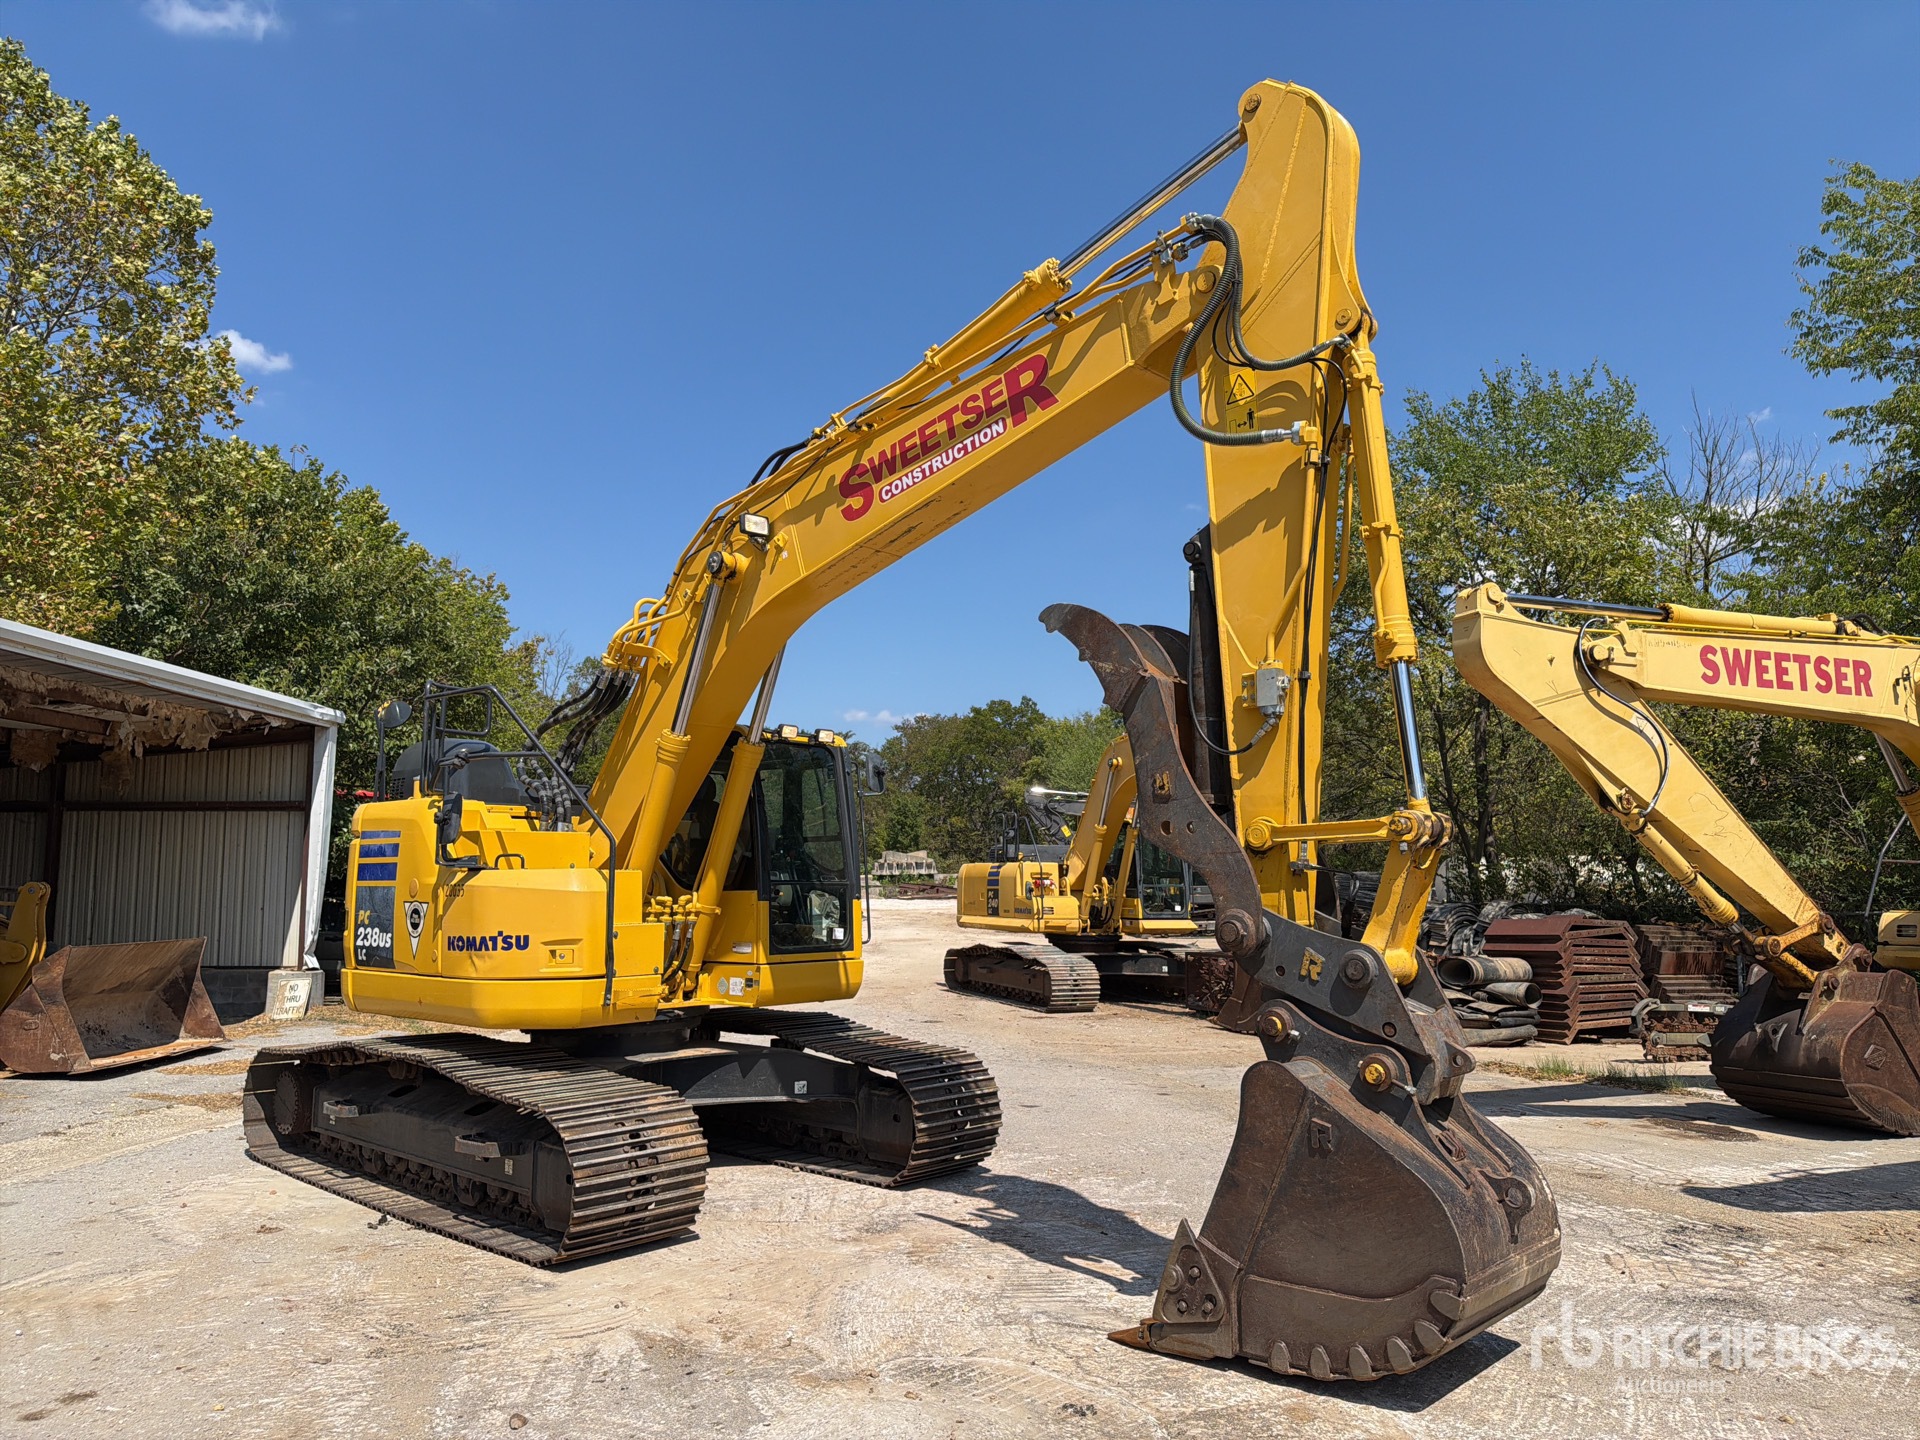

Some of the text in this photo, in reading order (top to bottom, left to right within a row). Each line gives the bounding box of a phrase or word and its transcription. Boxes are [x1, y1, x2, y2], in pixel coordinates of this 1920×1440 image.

[838, 354, 1059, 522] SWEETSER
[880, 418, 1004, 501] CONSTRUCTION
[1699, 644, 1873, 697] SWEETSER
[357, 909, 370, 925] PC
[447, 930, 530, 952] KOMATSU
[357, 948, 367, 961] LC
[289, 984, 299, 993] NO
[284, 995, 302, 1003] THRU
